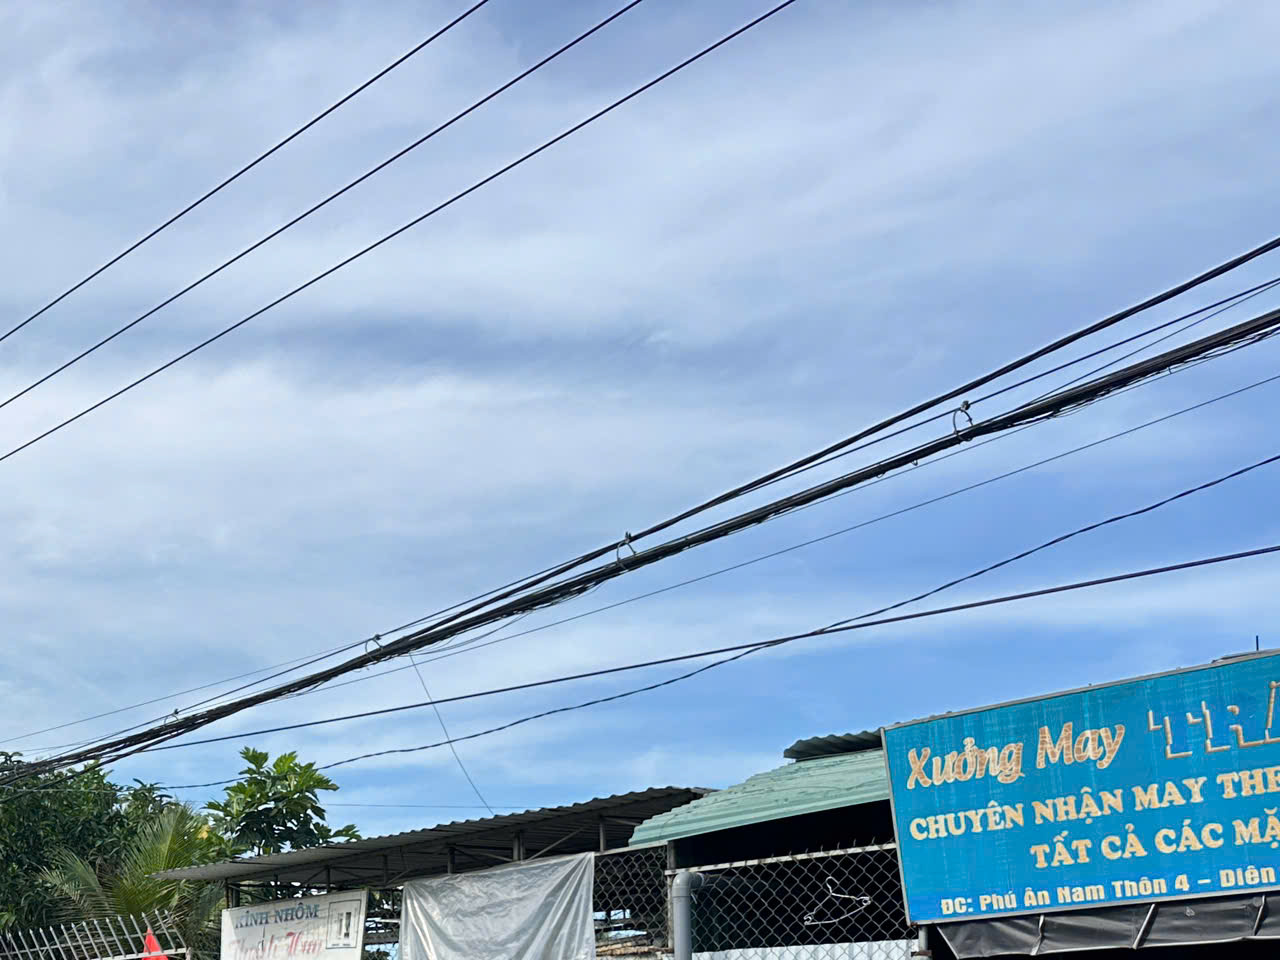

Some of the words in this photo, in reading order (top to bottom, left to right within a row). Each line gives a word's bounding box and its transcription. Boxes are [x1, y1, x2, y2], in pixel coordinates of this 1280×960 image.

[907, 737, 1025, 789] Xưởng
[1036, 722, 1126, 769] May
[909, 800, 1024, 841] CHUYÊN
[1032, 787, 1123, 824] NHẬN
[1131, 777, 1207, 812] MAY
[1030, 830, 1092, 868] TẤT
[1101, 823, 1148, 861] CẢ
[1154, 819, 1224, 854] CÁC
[273, 902, 320, 924] NHÔM
[941, 897, 973, 915] ĐC:
[979, 890, 1017, 911] Phú
[1056, 884, 1105, 904] Nam
[1111, 876, 1167, 898] Thôn
[1175, 874, 1190, 891] 4
